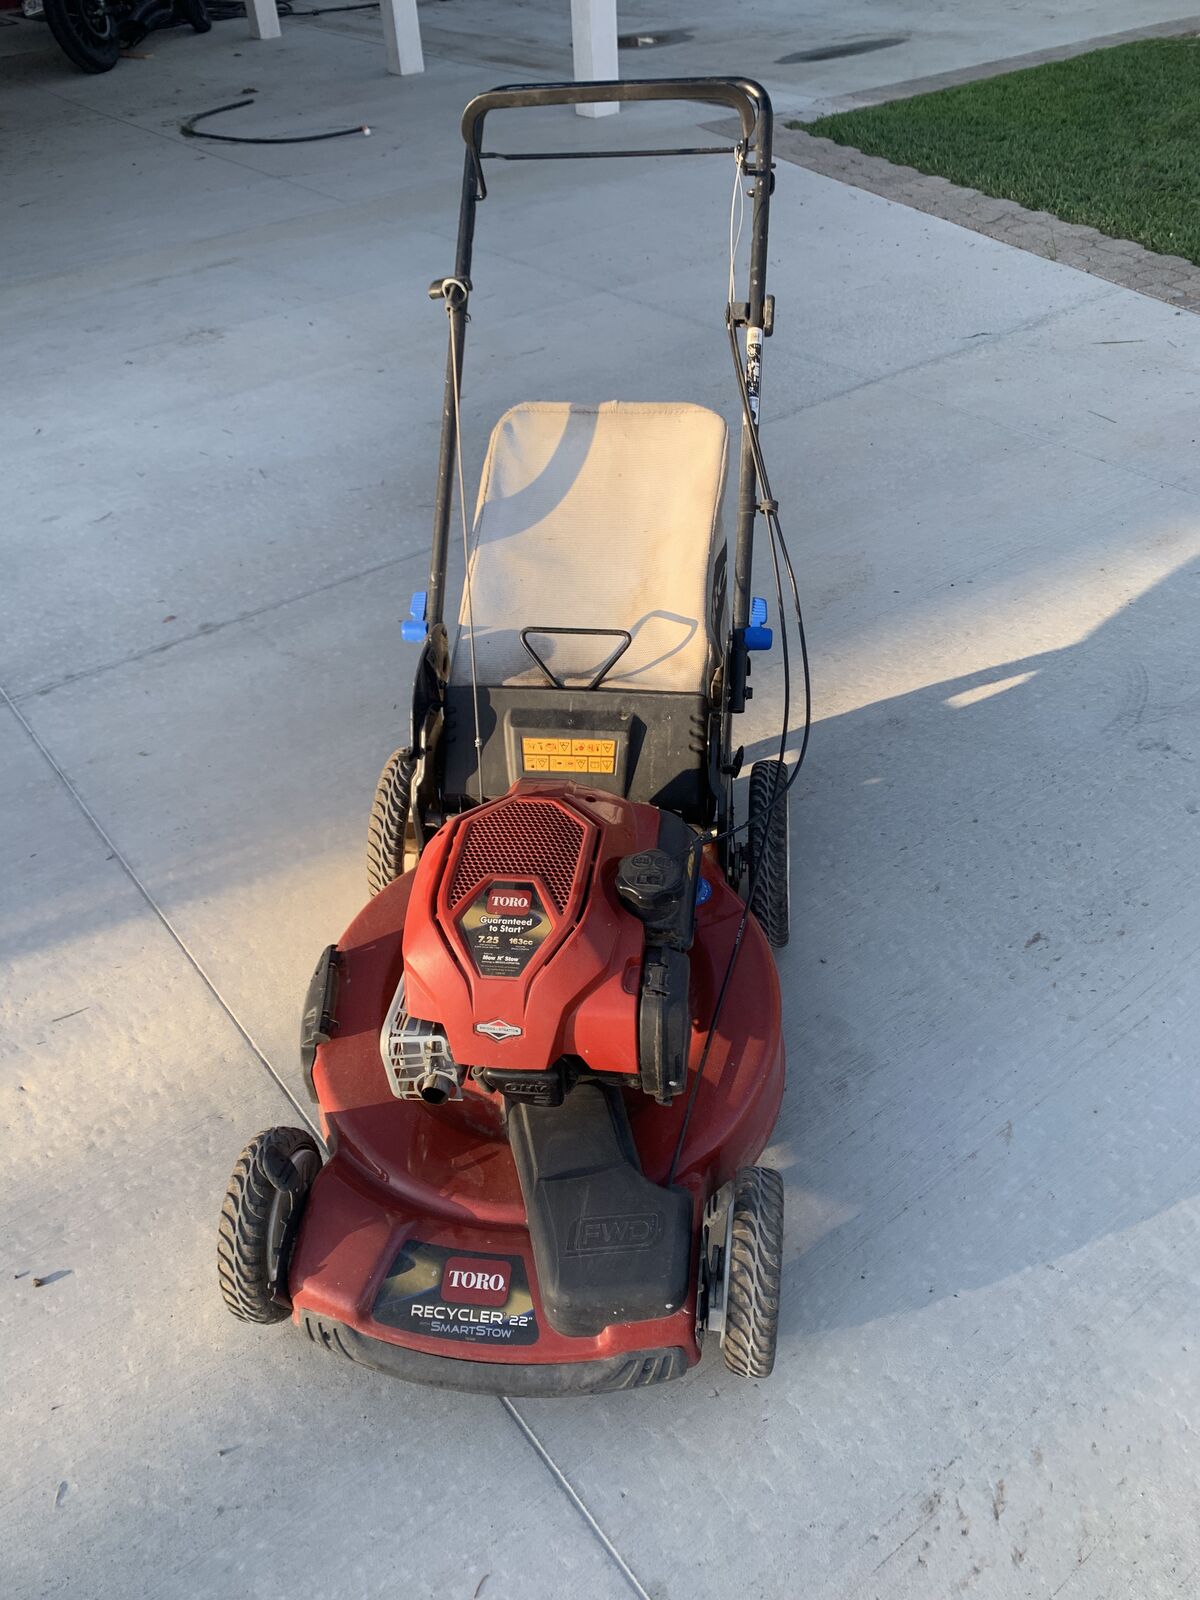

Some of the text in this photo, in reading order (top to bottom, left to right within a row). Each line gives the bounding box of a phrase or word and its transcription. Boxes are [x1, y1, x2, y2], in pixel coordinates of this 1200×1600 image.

[491, 896, 528, 908] TORO
[480, 916, 533, 926] Guaranteed
[489, 925, 498, 933] to
[478, 935, 500, 944] 7.25
[582, 1220, 650, 1245] FWD
[448, 1270, 505, 1291] TORO
[410, 1304, 533, 1327] RECYCLER 22"
